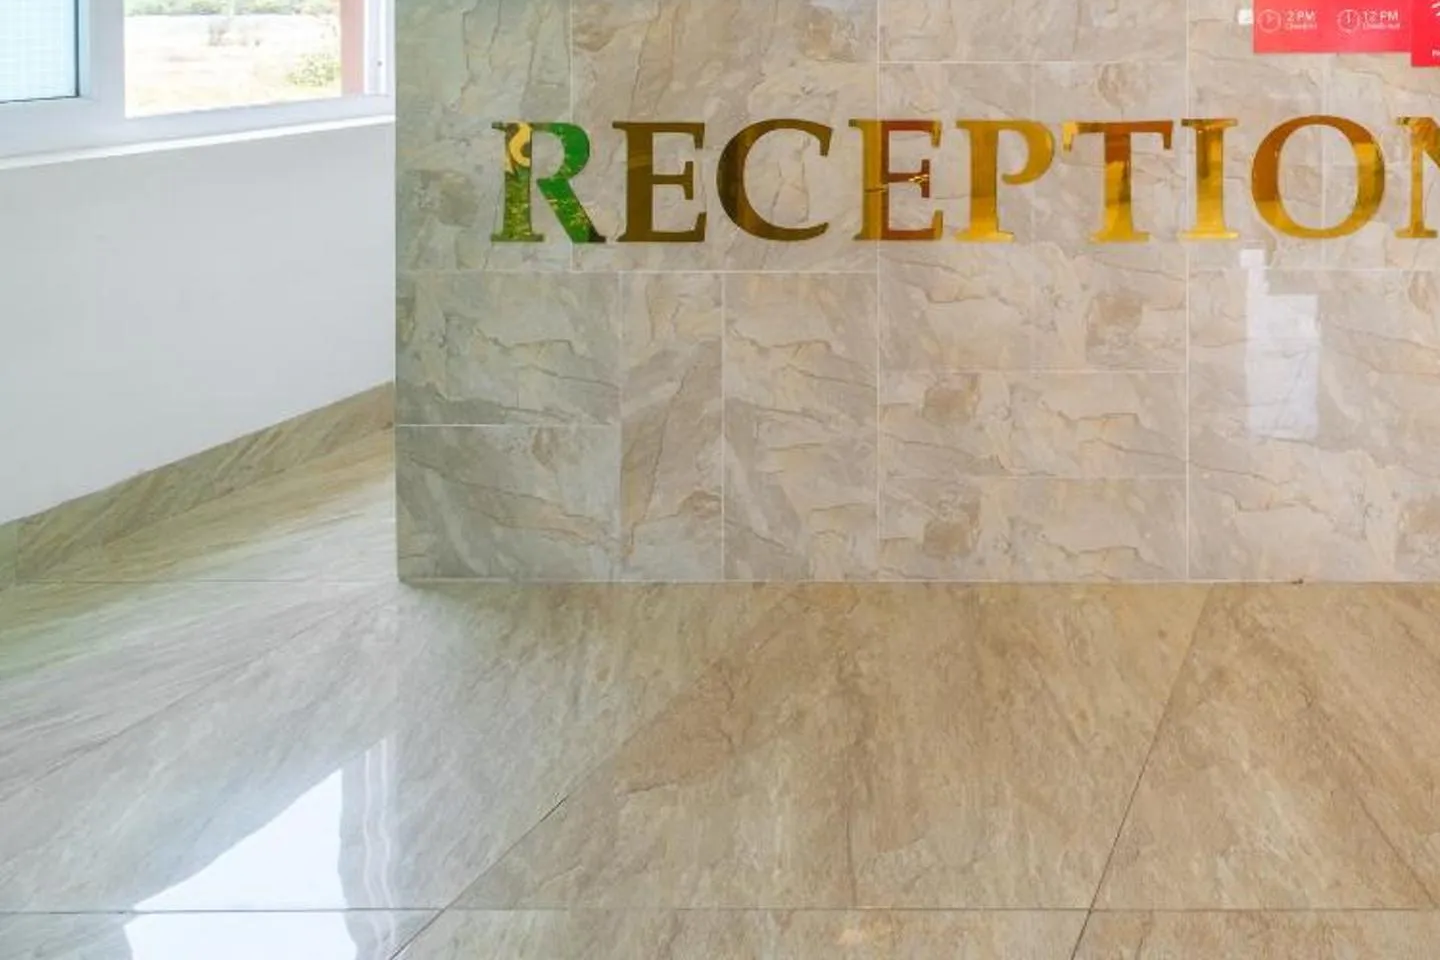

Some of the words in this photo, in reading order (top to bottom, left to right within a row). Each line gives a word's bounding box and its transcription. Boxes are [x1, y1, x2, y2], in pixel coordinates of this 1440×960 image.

[1286, 10, 1295, 22] 2
[1298, 10, 1316, 21] PM
[1364, 10, 1377, 23] 12
[1380, 10, 1399, 21] PM
